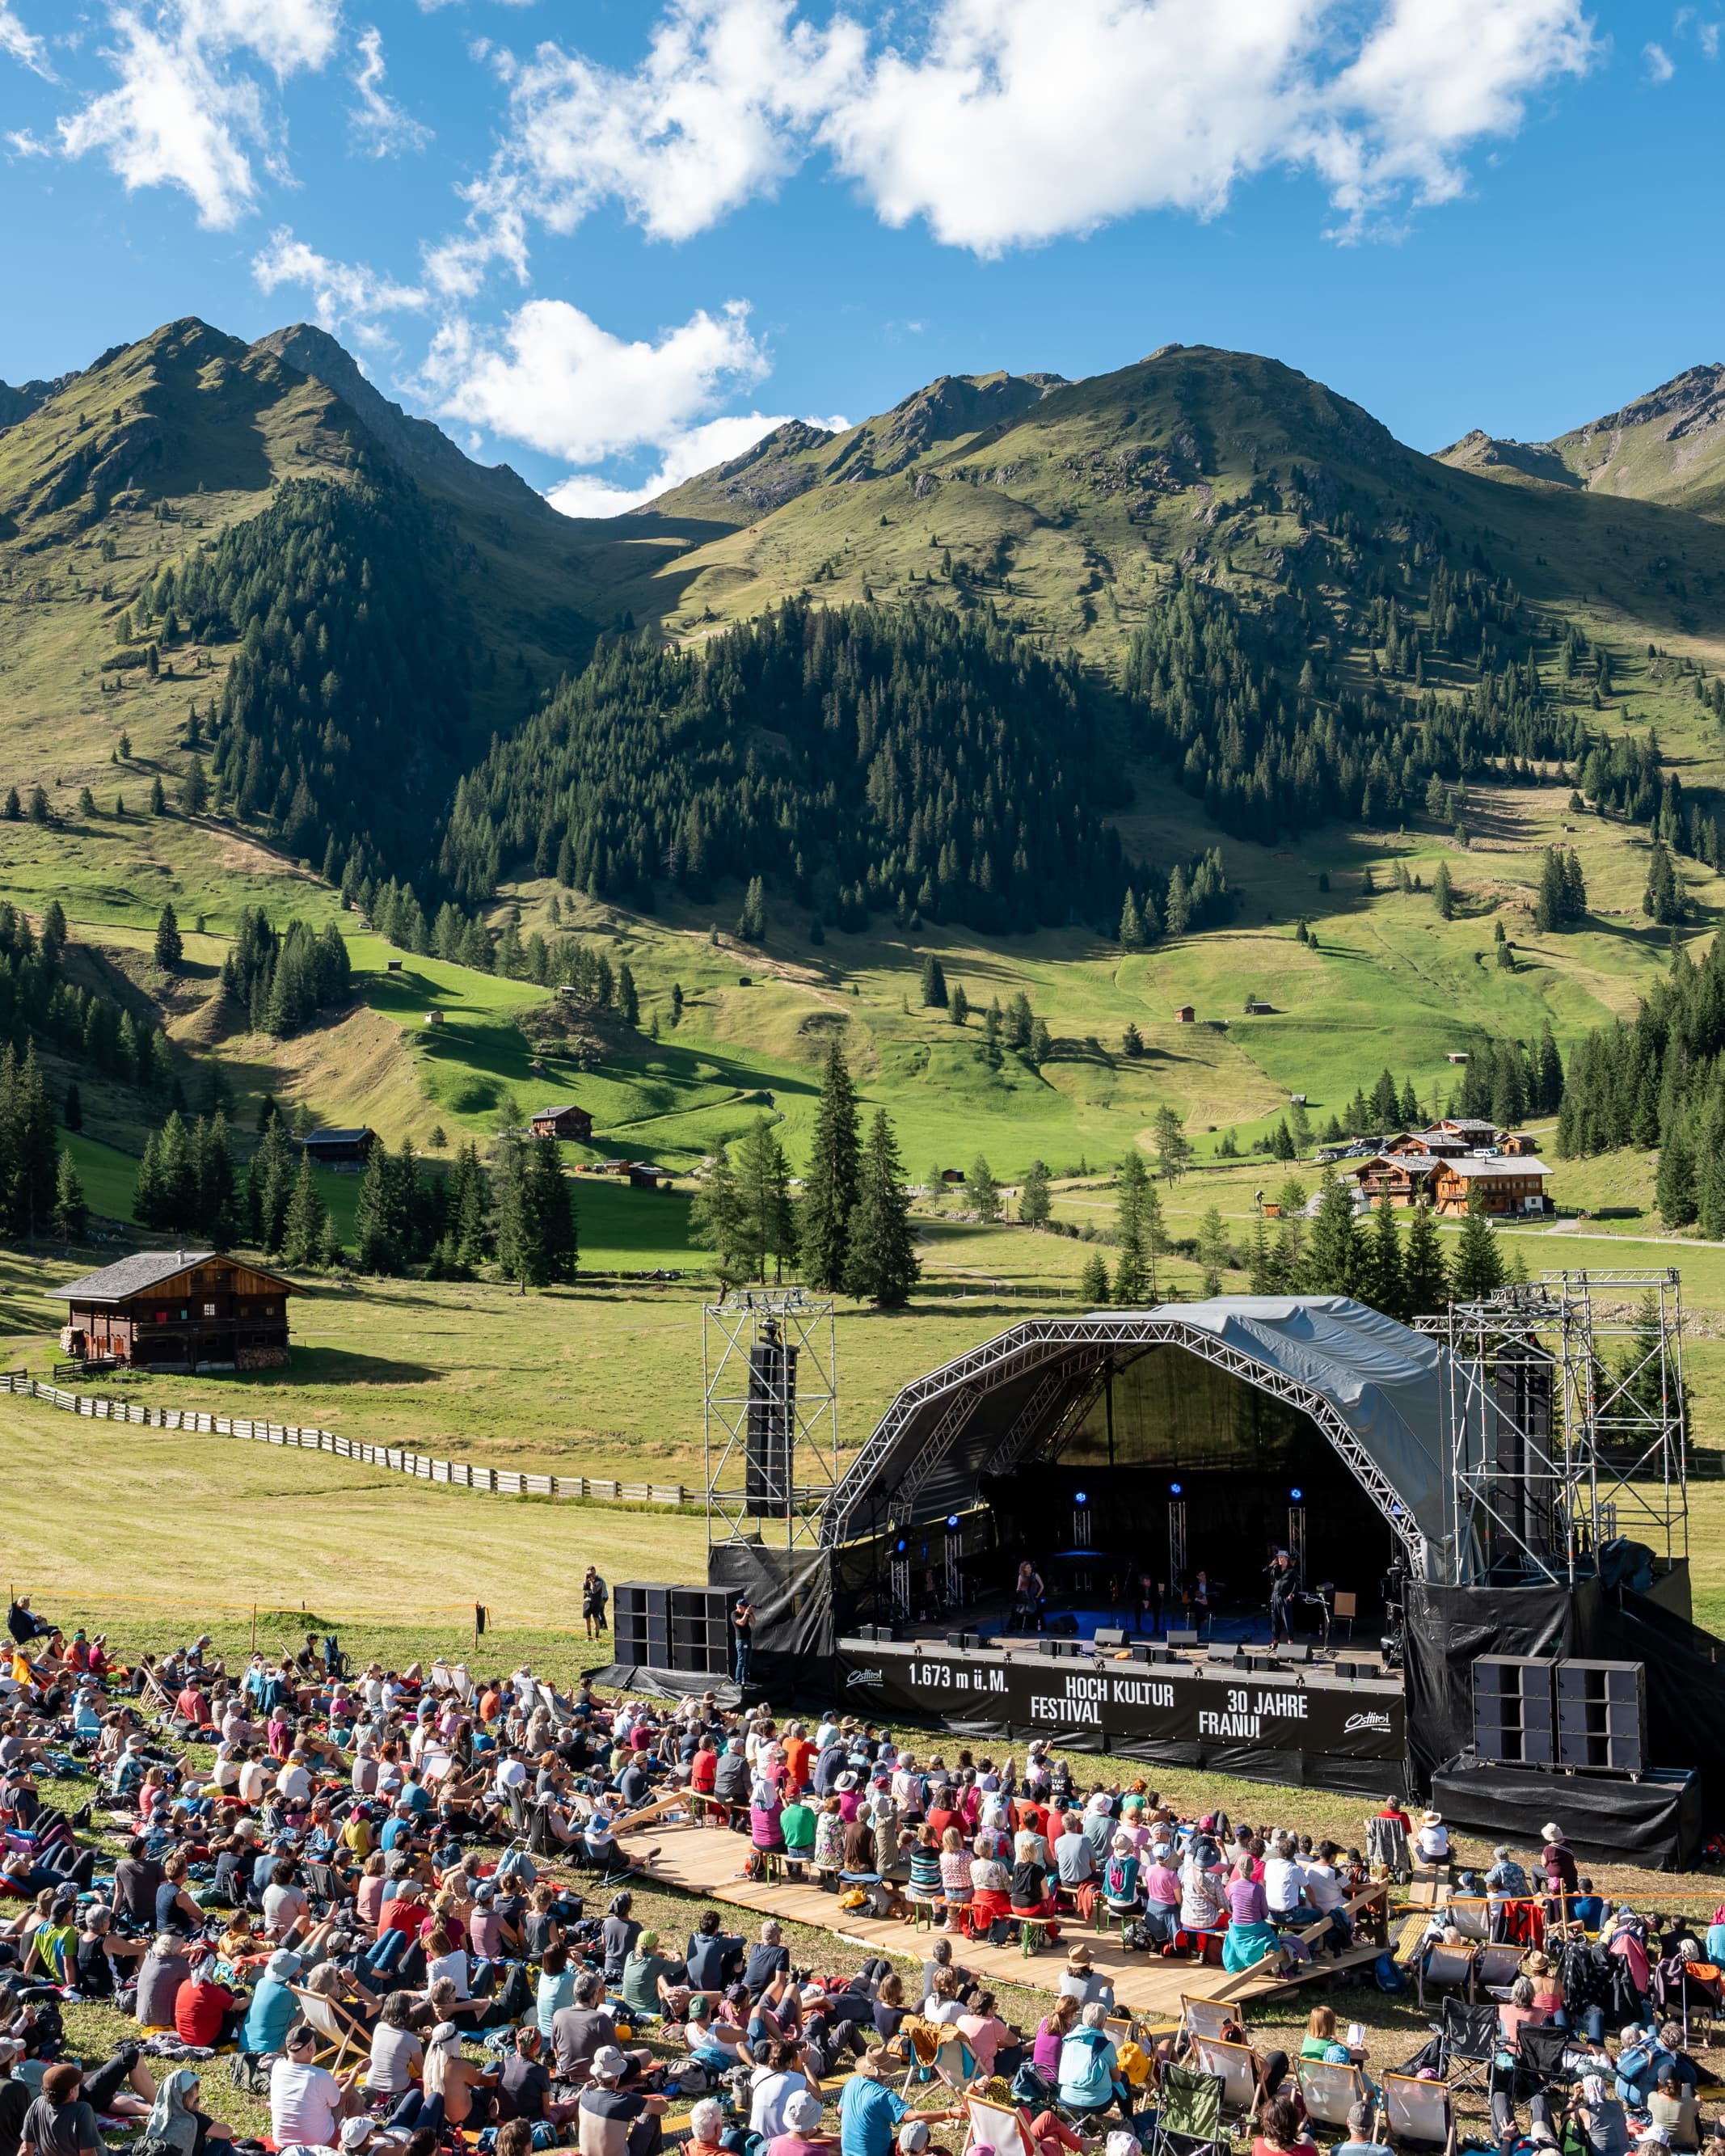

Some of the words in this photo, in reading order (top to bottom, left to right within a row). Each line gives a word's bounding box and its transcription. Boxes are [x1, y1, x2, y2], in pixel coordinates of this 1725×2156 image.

[847, 1669, 882, 1682] Osttirol
[909, 1663, 951, 1687] 1.673
[955, 1673, 969, 1689] m
[1065, 1676, 1107, 1702] HOCH
[1113, 1680, 1175, 1707] KULTUR
[1227, 1690, 1248, 1713] 30
[1254, 1692, 1309, 1719] JAHRE
[1031, 1696, 1103, 1724] FESTIVAL
[1345, 1711, 1389, 1728] Osttirol
[1199, 1711, 1260, 1739] FRANUI
